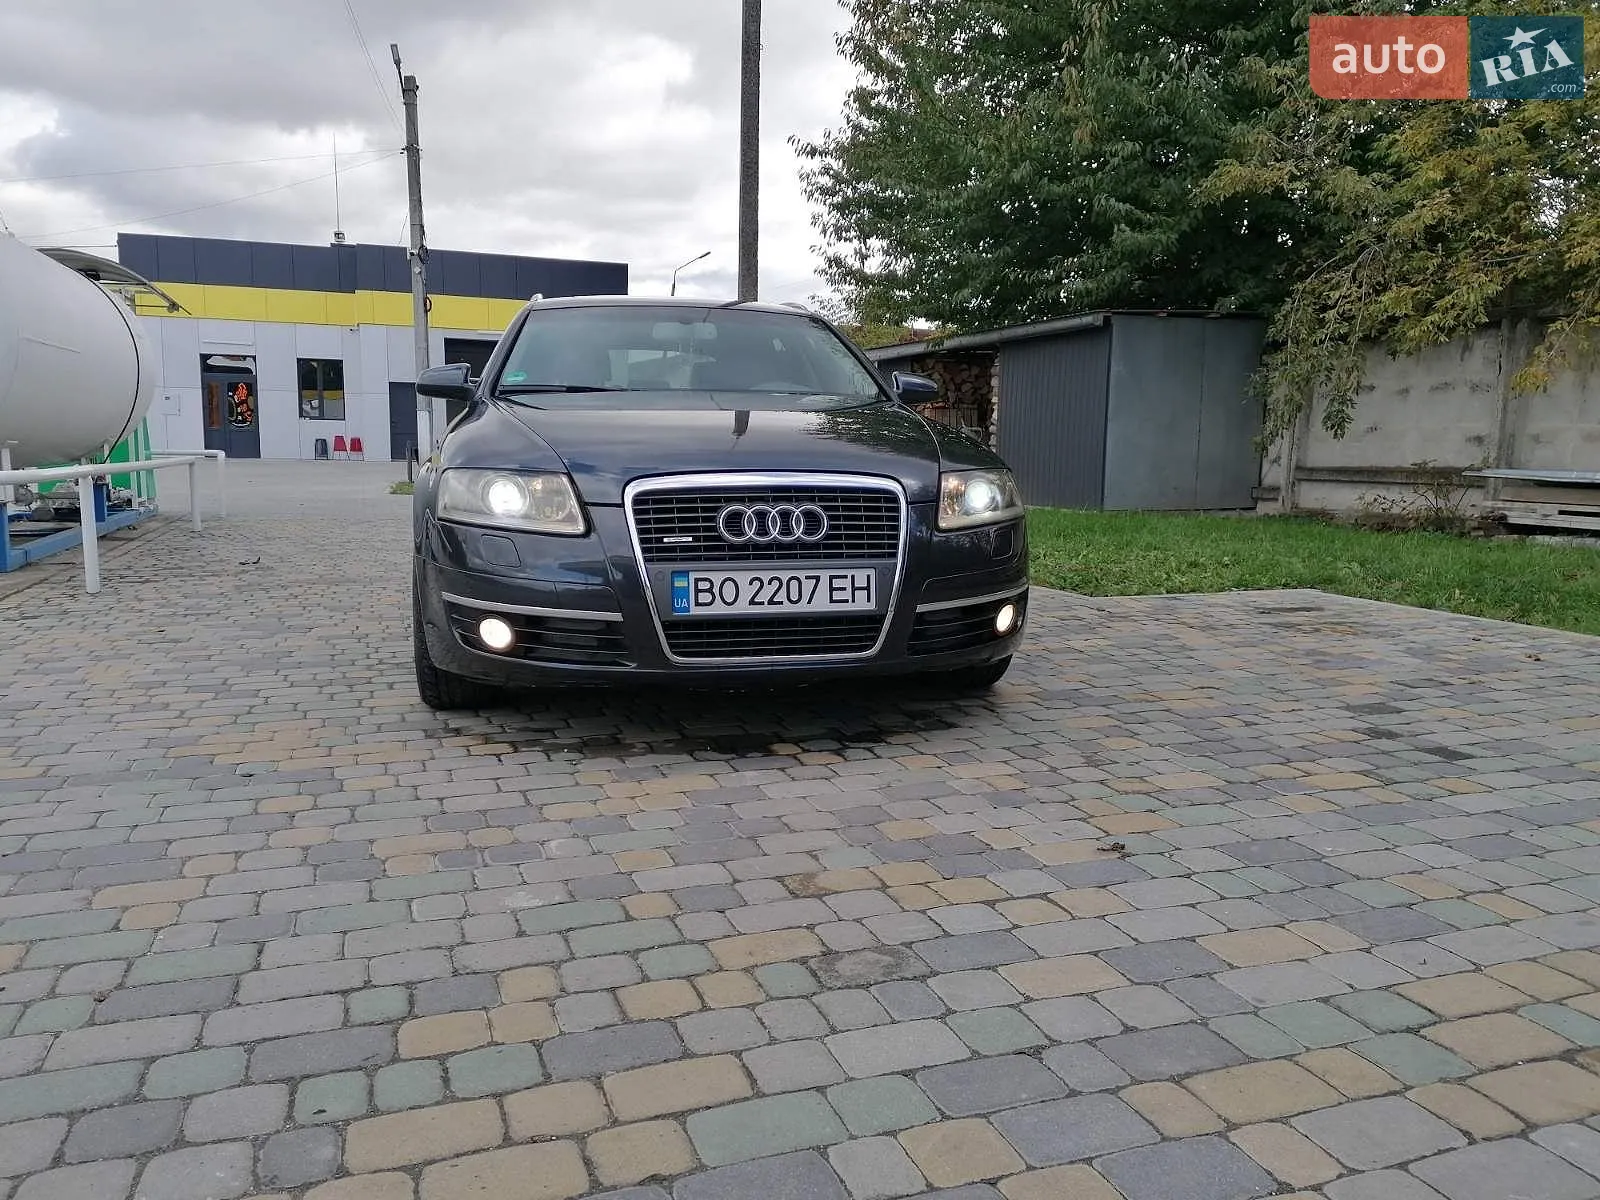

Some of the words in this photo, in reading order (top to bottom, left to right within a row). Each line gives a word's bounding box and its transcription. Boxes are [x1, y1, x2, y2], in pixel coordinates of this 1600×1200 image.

[693, 576, 740, 607] BO
[748, 575, 821, 606] 2207
[828, 574, 871, 604] EH
[674, 598, 689, 609] UA
